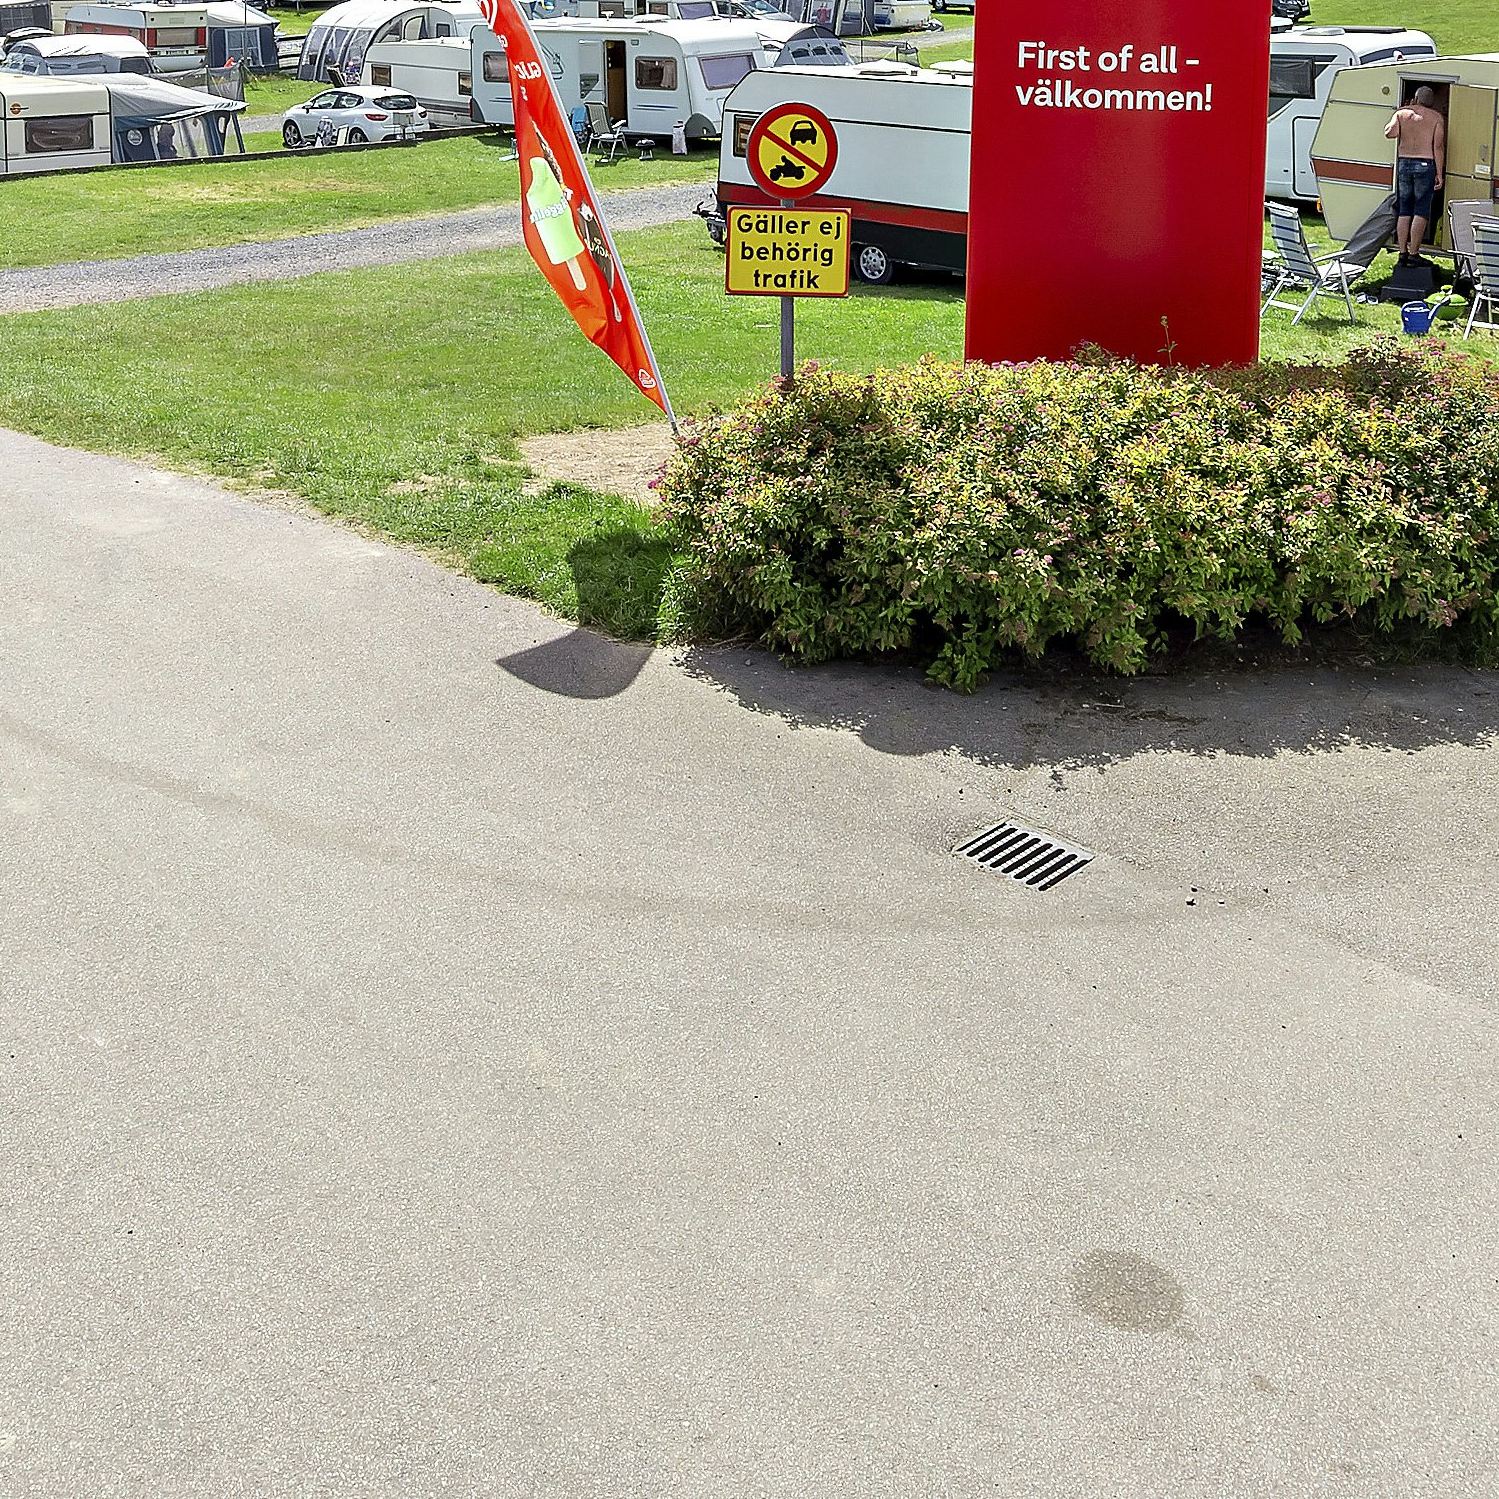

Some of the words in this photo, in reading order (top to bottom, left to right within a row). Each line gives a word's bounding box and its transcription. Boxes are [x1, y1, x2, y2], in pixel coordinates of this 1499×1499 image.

[1018, 41, 1090, 71] First
[1098, 45, 1133, 72] of
[1139, 45, 1178, 73] all
[1015, 79, 1213, 111] välkommen!
[737, 214, 811, 235] Gäller
[819, 216, 841, 240] ej
[740, 241, 833, 267] behörig
[753, 269, 820, 289] trafik
